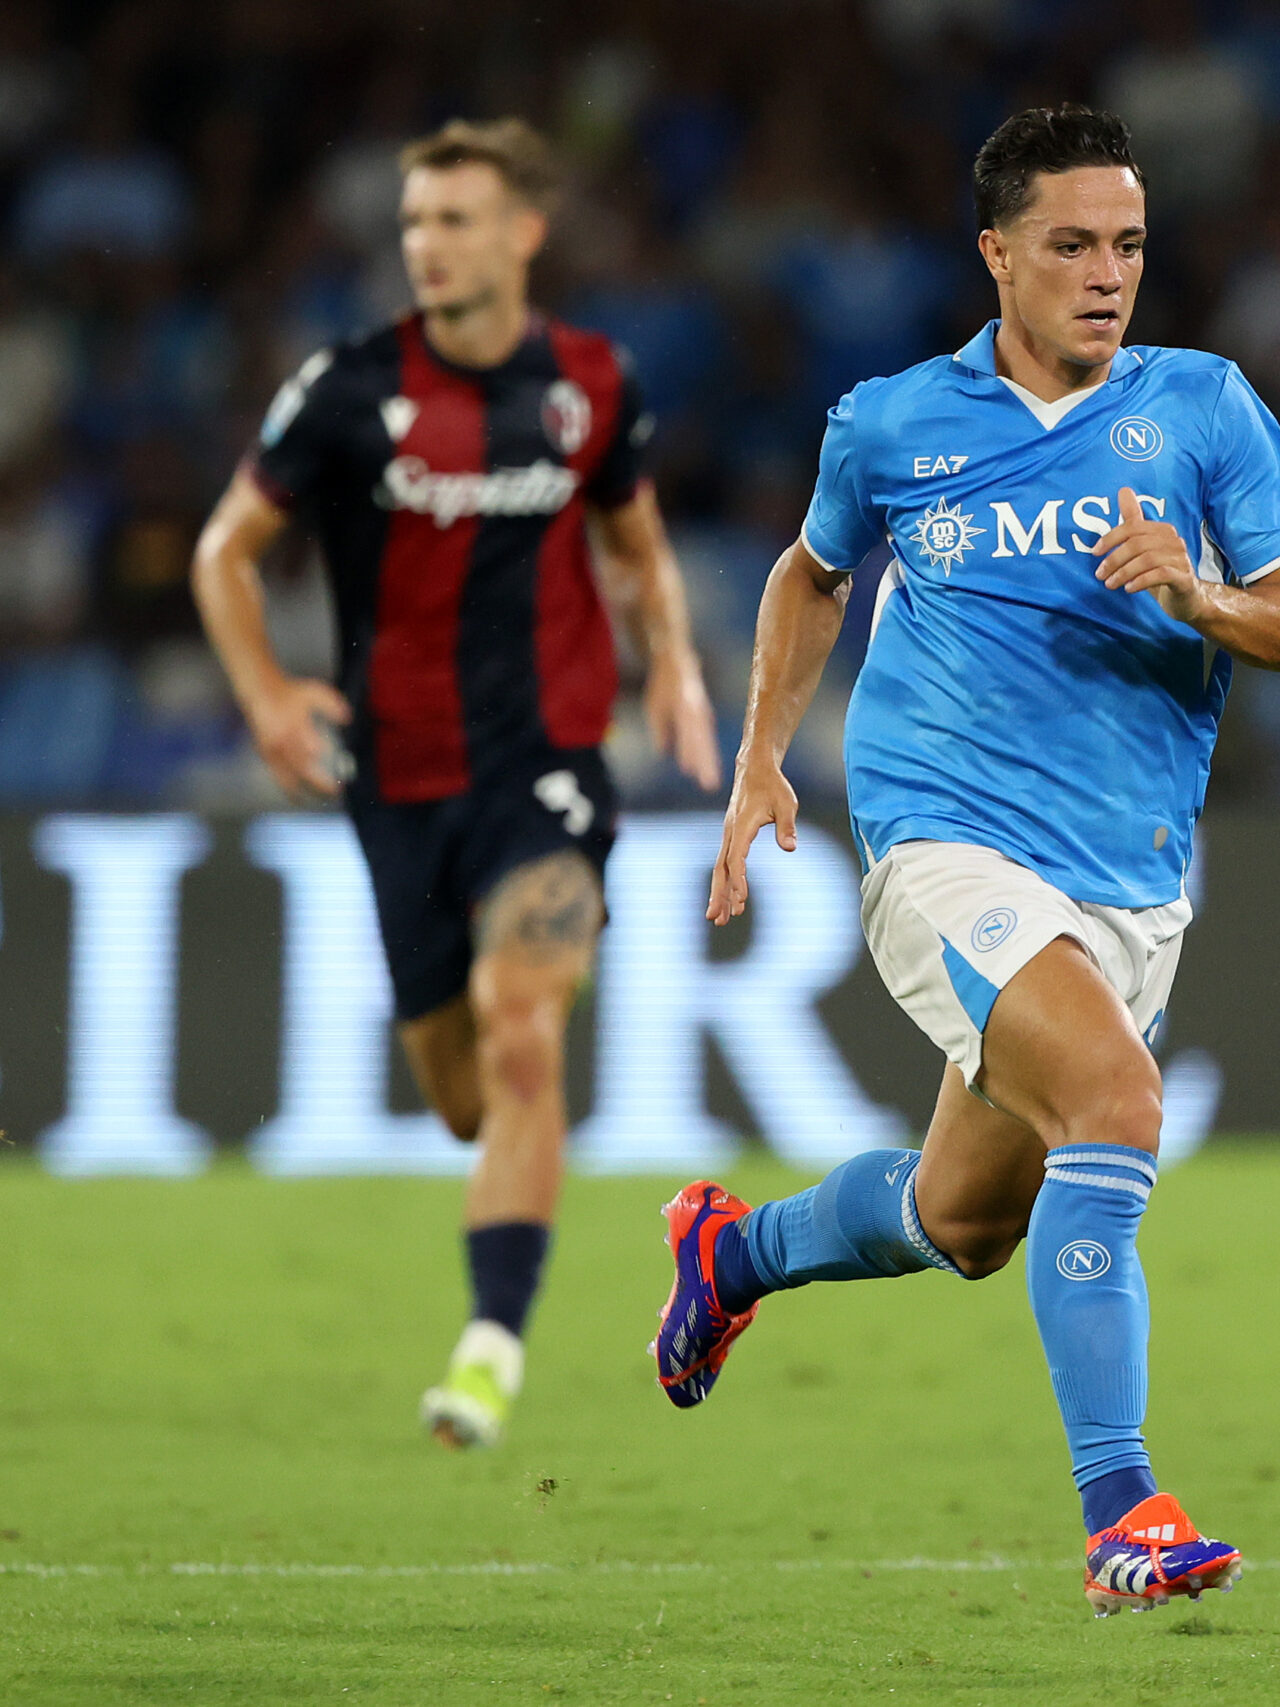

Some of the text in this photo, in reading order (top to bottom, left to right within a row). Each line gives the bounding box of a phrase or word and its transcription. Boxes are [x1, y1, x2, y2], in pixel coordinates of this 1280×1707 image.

[1125, 427, 1147, 449] N
[914, 455, 969, 477] EA7
[982, 917, 1004, 941] N
[1071, 1249, 1095, 1272] N
